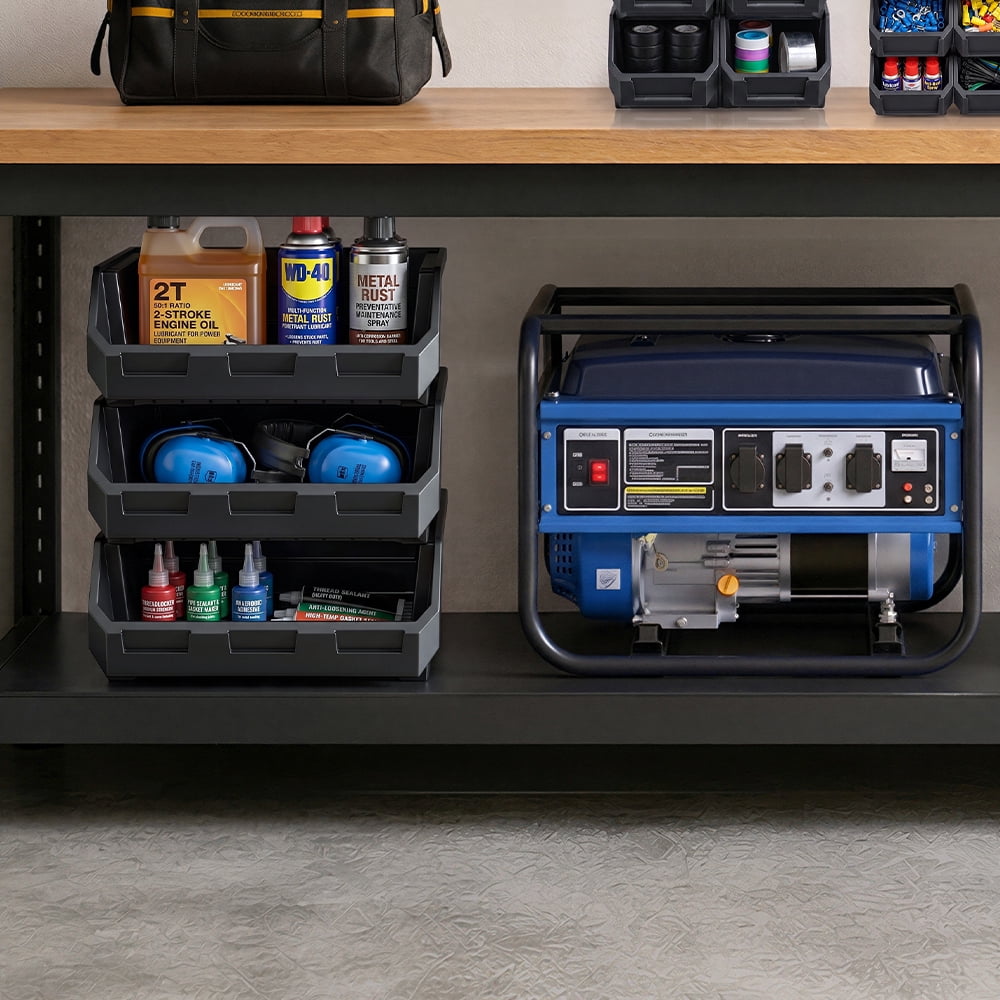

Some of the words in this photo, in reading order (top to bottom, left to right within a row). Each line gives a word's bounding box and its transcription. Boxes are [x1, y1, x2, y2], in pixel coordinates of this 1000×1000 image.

[285, 263, 330, 282] WD-40
[358, 274, 400, 287] METAL
[154, 282, 186, 300] 2T
[362, 288, 395, 301] RUST
[356, 302, 401, 310] PREVENTATIVE
[154, 310, 211, 318] 2-STROKE
[282, 314, 309, 324] METAL
[312, 314, 332, 322] RUST
[154, 320, 196, 328] ENGINE
[200, 320, 218, 329] OIL
[308, 604, 357, 614] ANTI-LOOSENING
